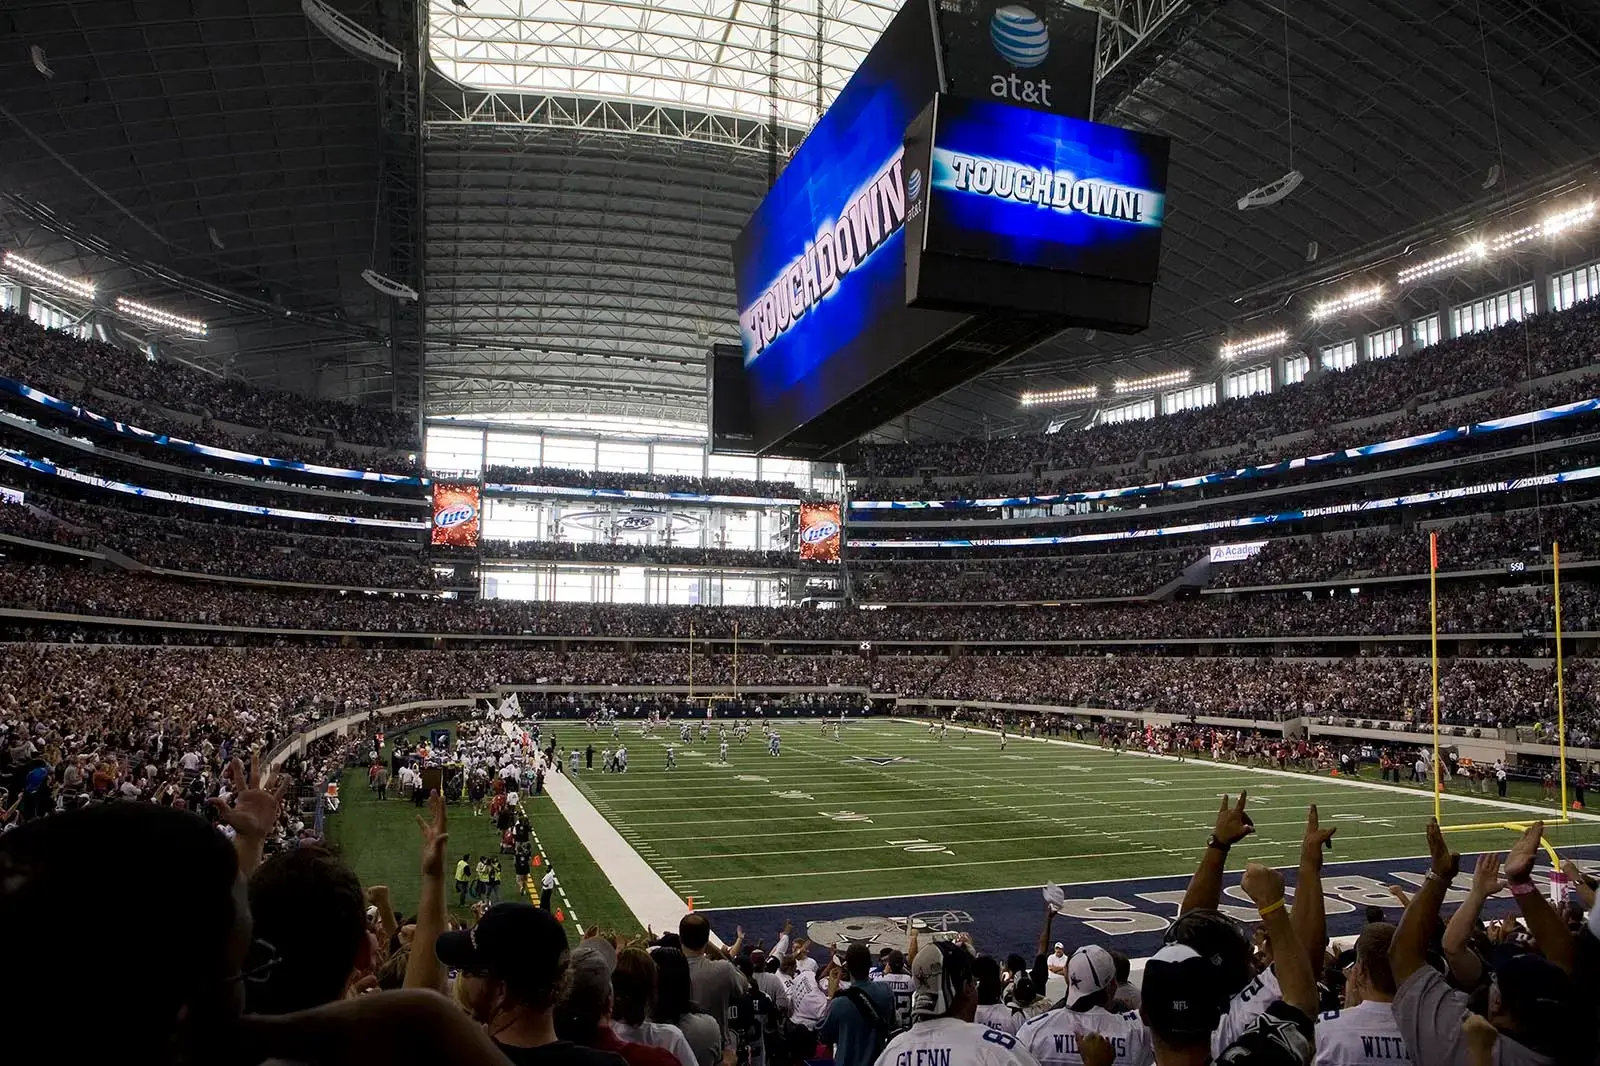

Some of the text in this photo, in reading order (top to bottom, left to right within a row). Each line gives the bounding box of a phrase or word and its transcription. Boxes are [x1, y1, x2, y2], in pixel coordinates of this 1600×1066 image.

[990, 73, 1052, 107] at&t
[952, 155, 1144, 222] TOUCHDOWN!
[750, 158, 906, 354] TOUCHDOWN
[442, 510, 470, 526] Lite
[808, 526, 833, 541] Lite
[1172, 1000, 1189, 1011] NFL
